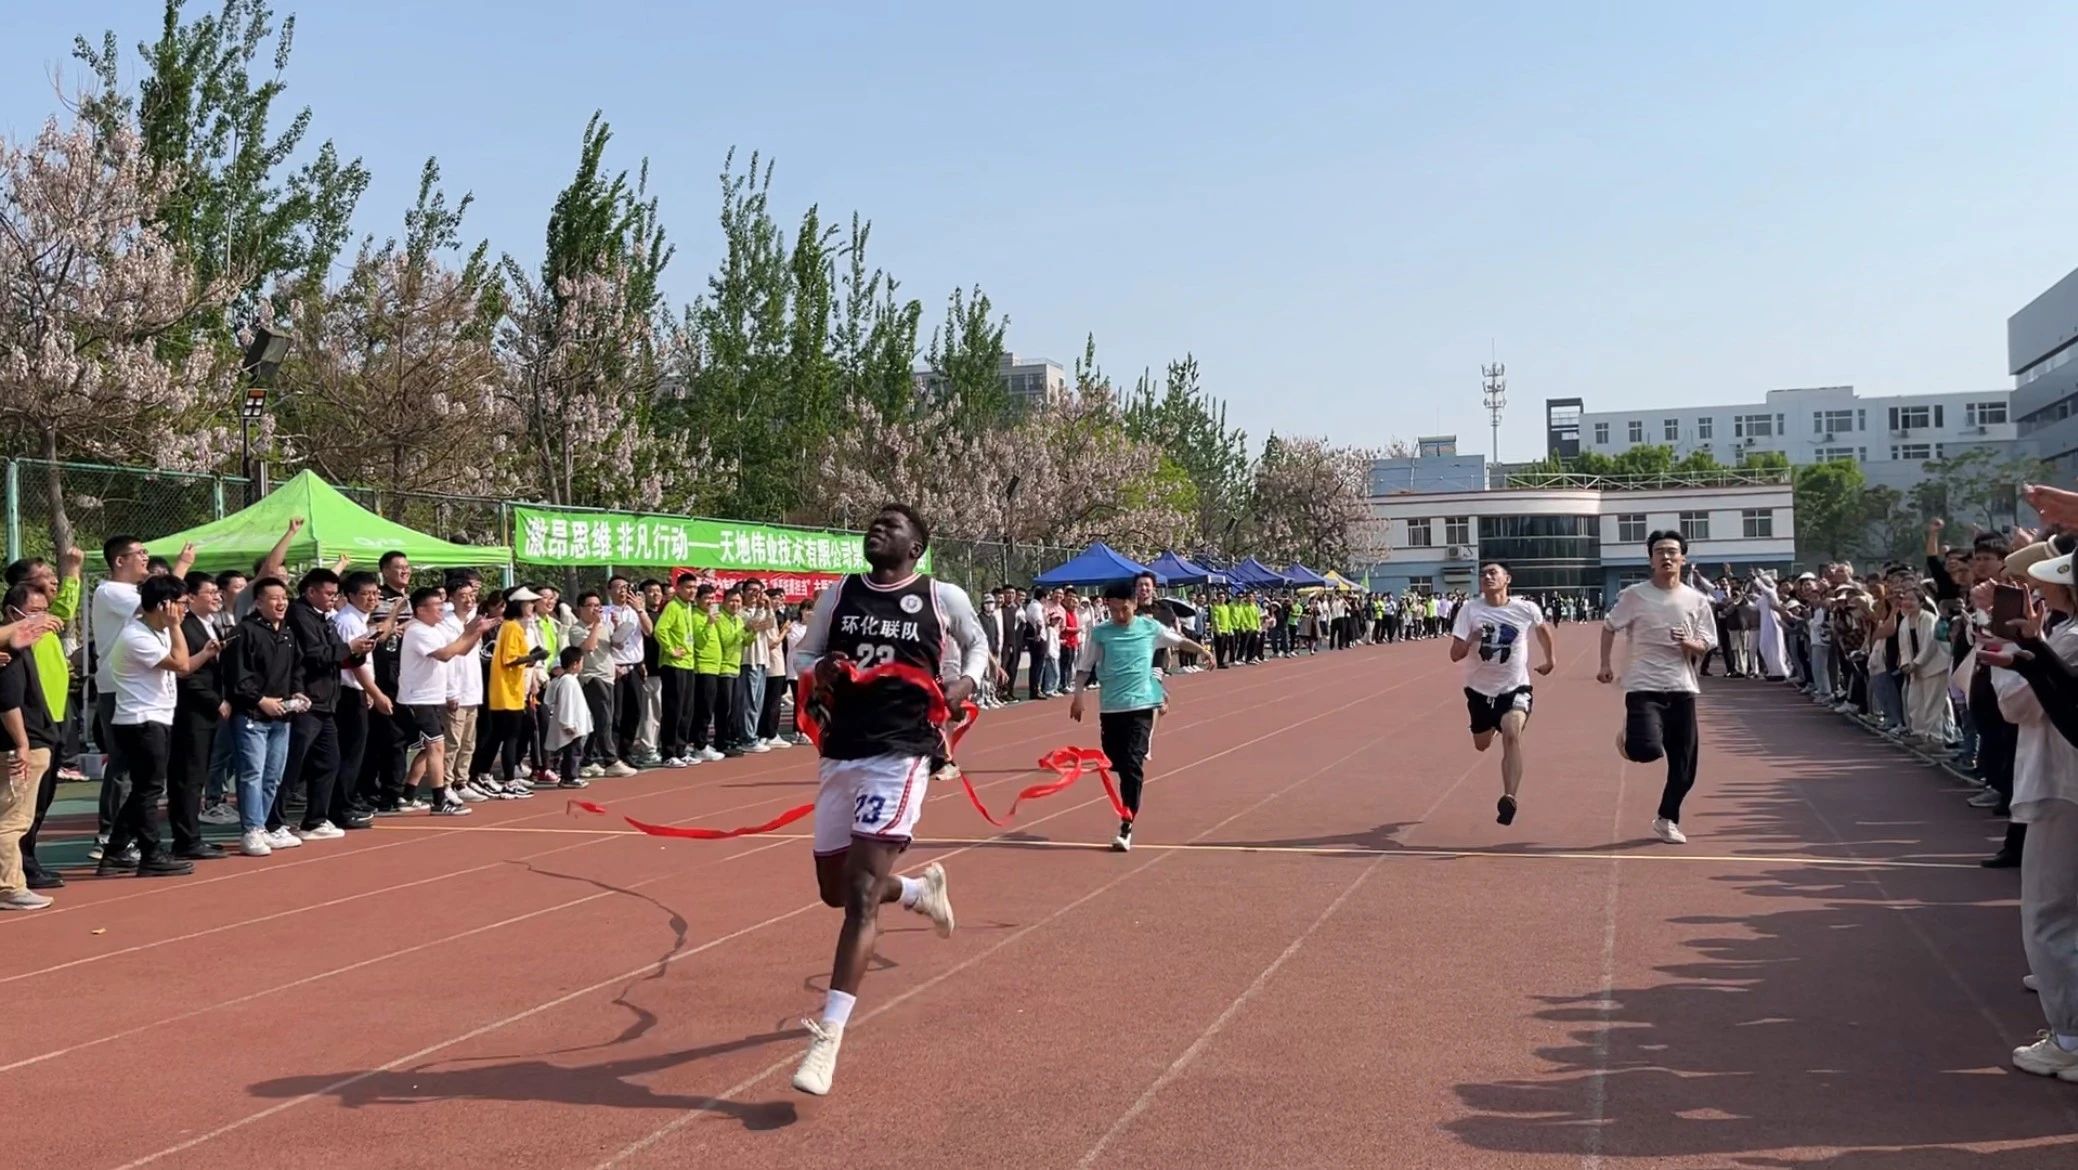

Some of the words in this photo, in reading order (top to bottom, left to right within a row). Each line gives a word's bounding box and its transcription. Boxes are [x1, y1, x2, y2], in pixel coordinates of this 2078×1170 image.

[841, 615, 920, 642] 环化联队
[854, 794, 886, 824] 23
